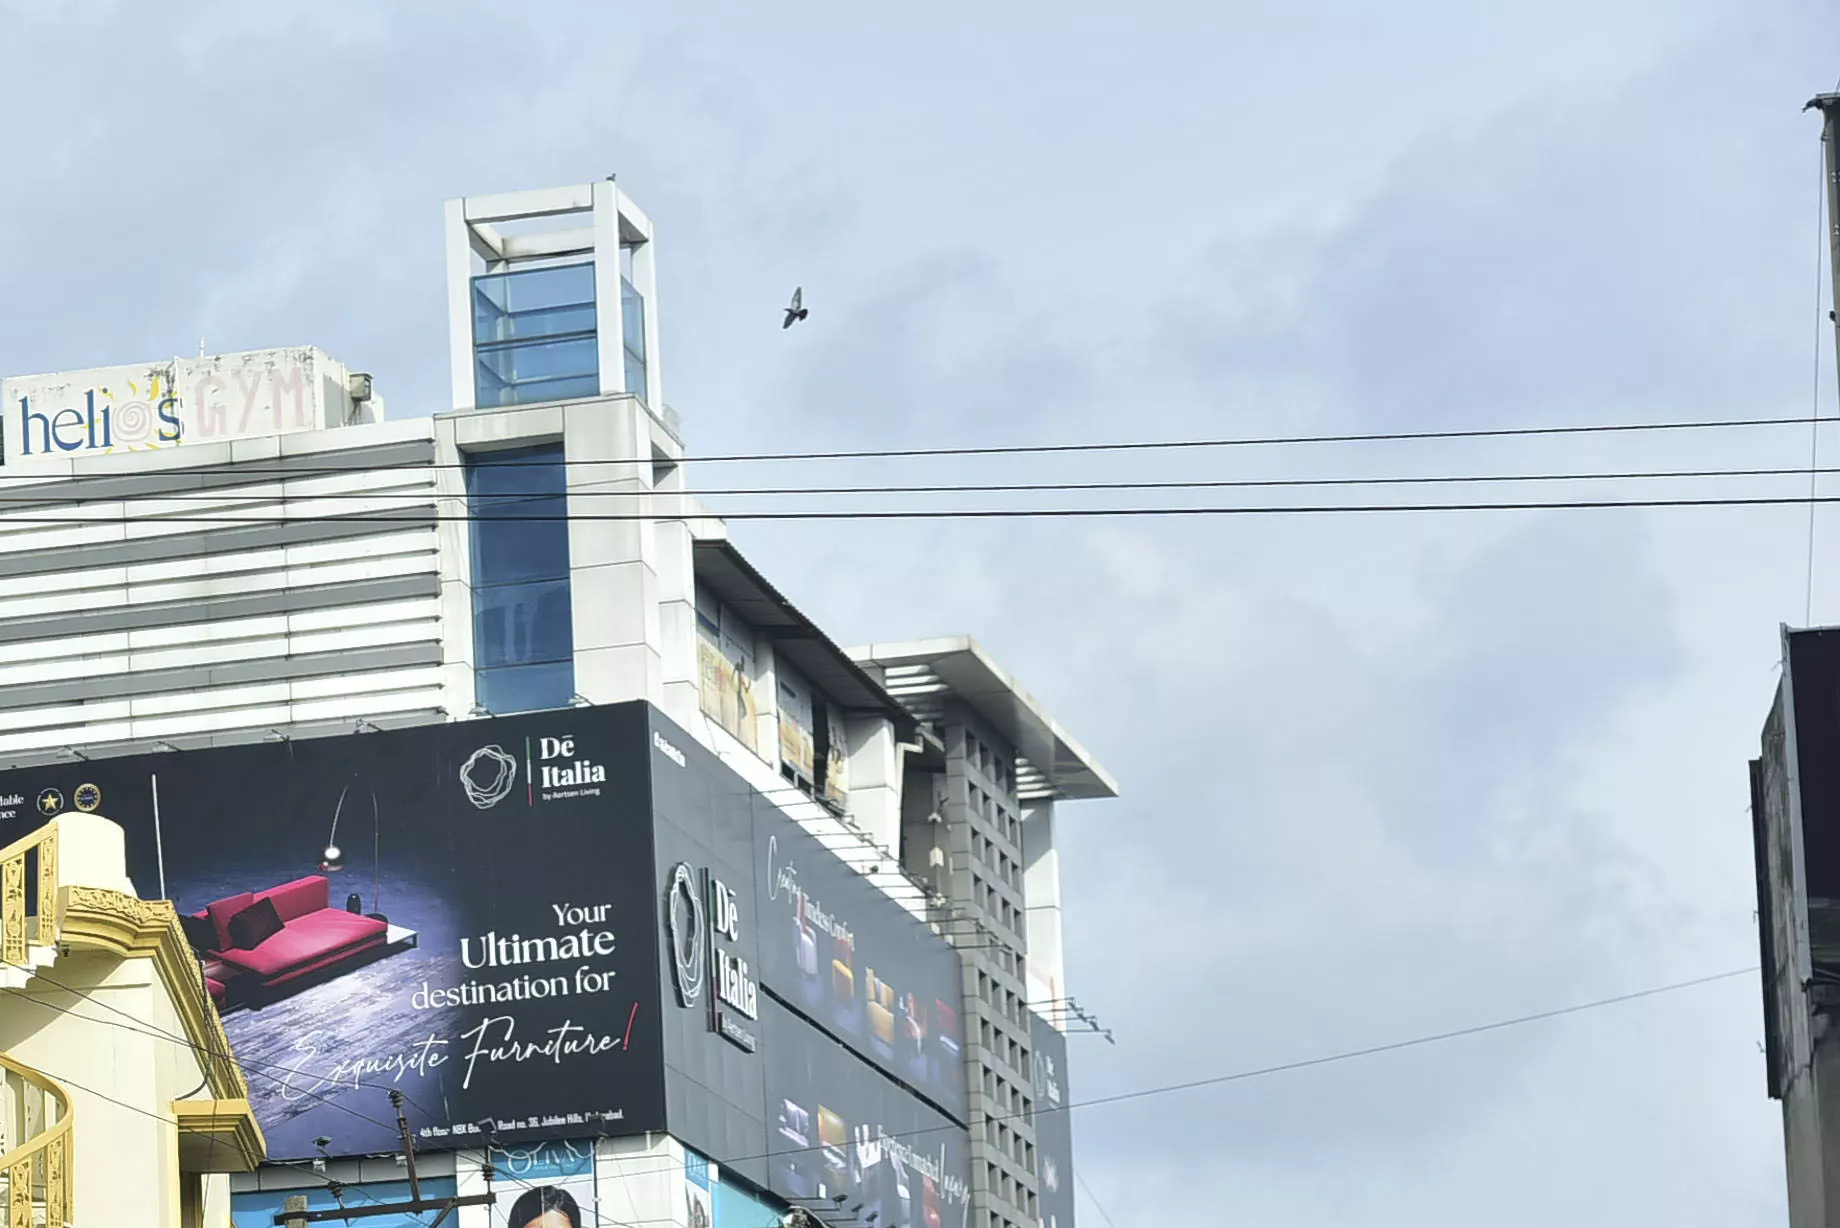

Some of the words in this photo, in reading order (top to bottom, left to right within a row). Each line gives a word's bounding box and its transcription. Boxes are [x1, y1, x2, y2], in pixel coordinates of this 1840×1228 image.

[17, 386, 184, 456] helios
[194, 366, 306, 438] GYM
[540, 760, 607, 789] Italia
[552, 902, 612, 927] Your
[459, 928, 616, 970] Ultimate
[411, 973, 568, 1012] destination
[574, 964, 616, 994] for
[717, 948, 759, 1021] Italia
